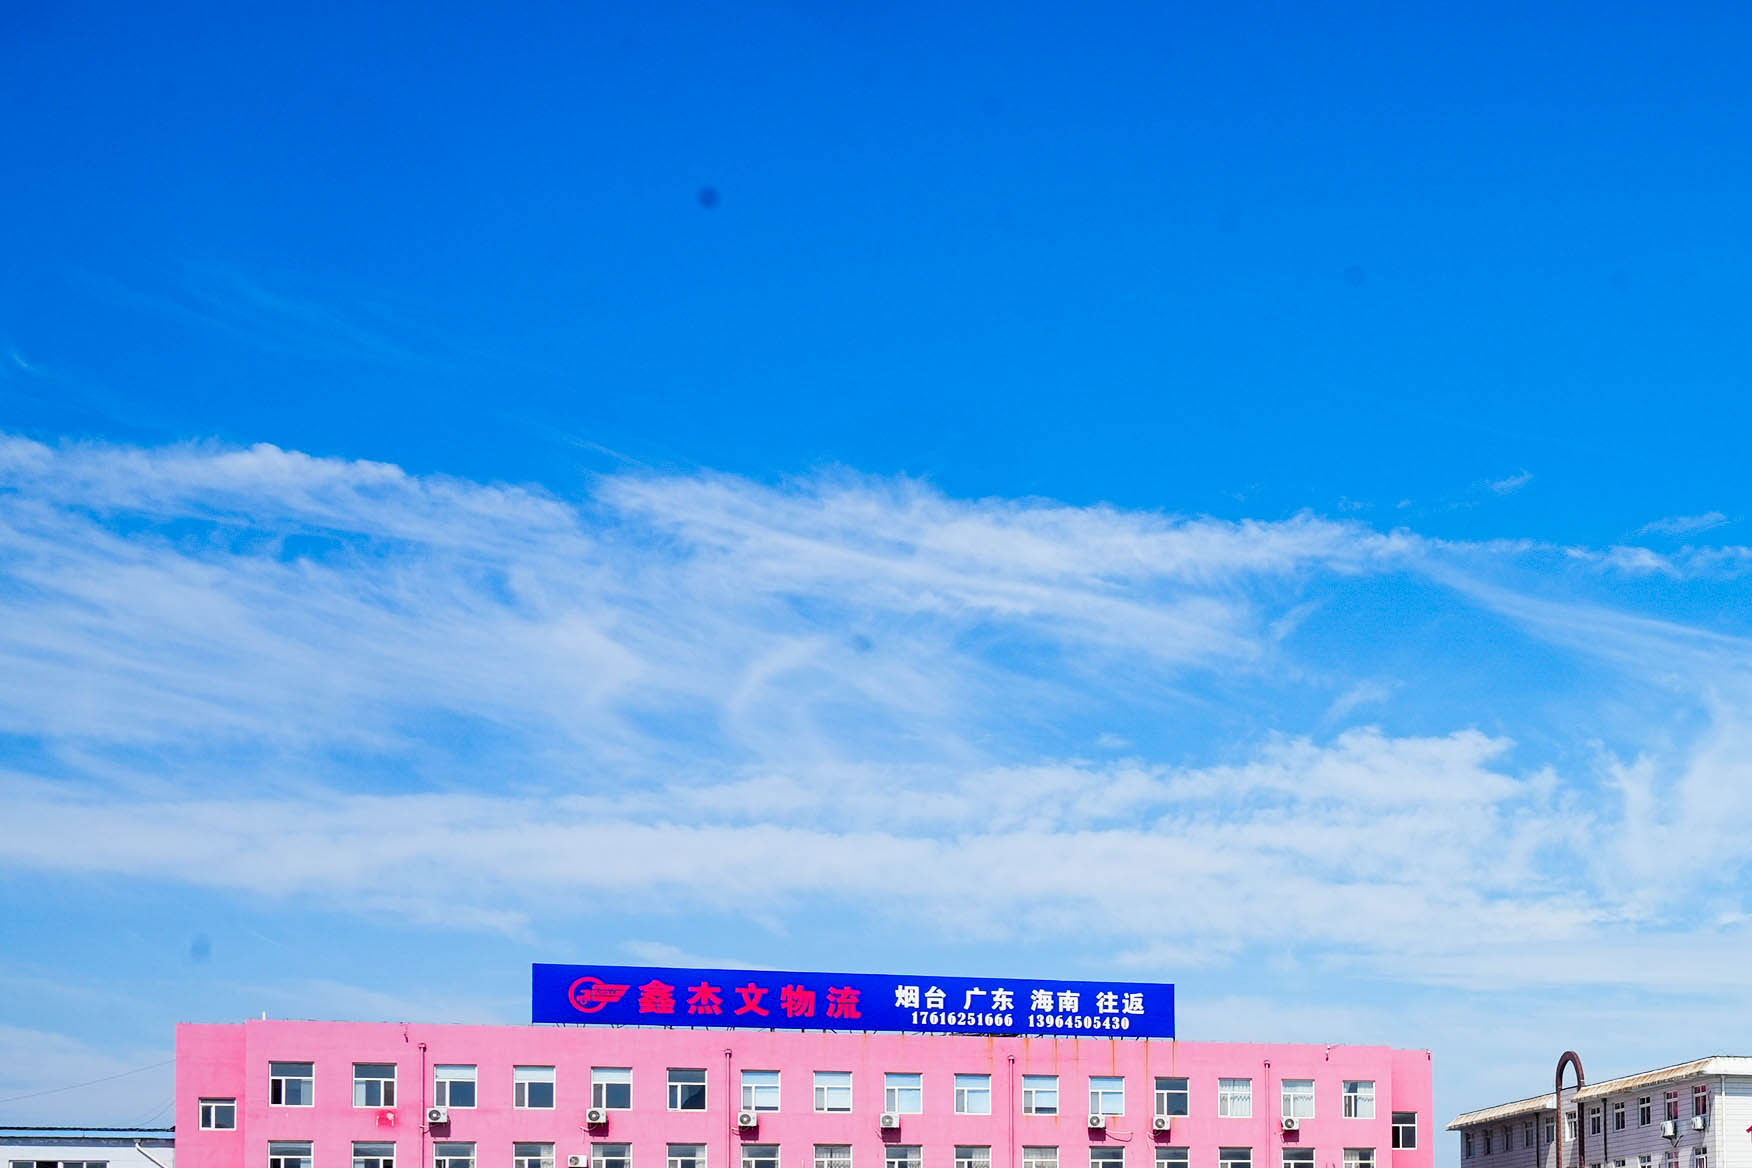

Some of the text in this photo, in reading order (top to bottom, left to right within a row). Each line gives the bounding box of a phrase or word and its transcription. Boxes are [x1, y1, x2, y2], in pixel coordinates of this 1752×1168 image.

[638, 979, 863, 1019] 鑫杰文物流
[895, 985, 1145, 1015] 烟台 广东 海南 往返
[911, 1011, 1130, 1030] 17616251666 13964505430
